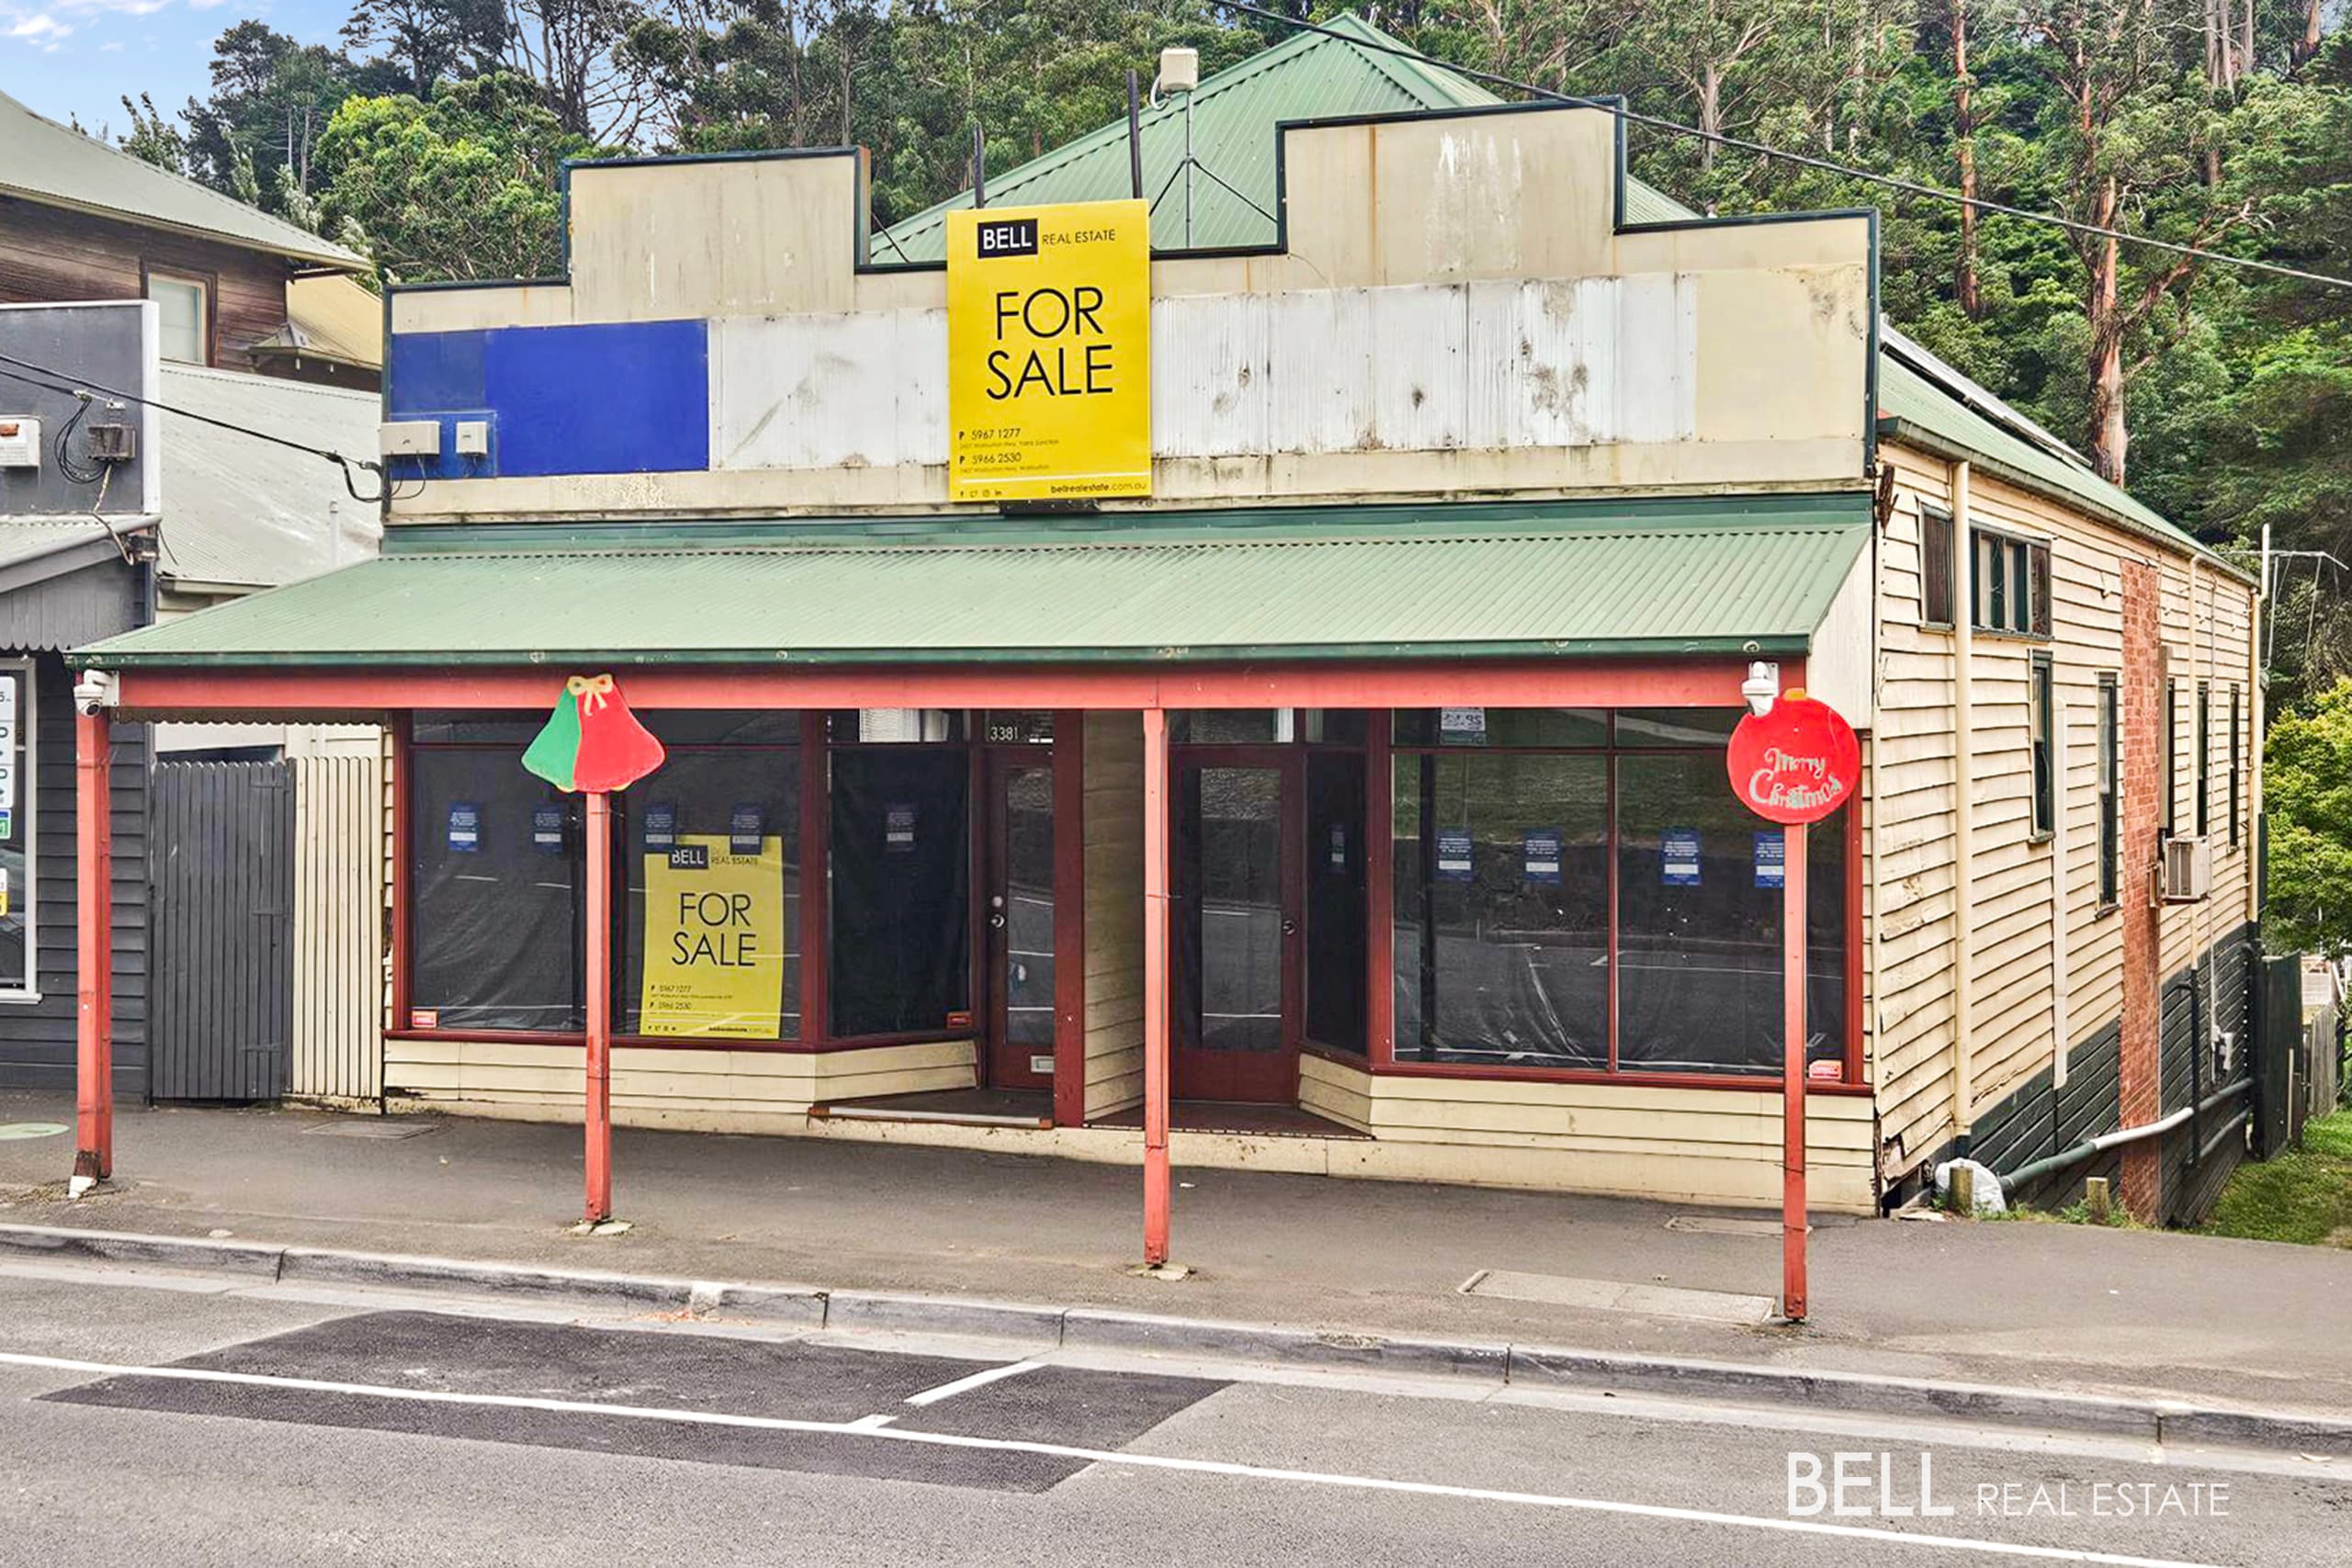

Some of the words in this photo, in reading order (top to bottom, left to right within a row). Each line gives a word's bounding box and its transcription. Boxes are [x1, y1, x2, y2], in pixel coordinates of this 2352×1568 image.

[983, 226, 1032, 250] BELL
[1042, 232, 1071, 245] REAL
[1075, 229, 1115, 243] ESTATE
[996, 287, 1103, 340] FOR
[986, 344, 1114, 400] SALE
[959, 431, 965, 440] P
[971, 429, 994, 441] 5967
[998, 428, 1021, 438] 1277
[959, 455, 965, 465] P
[972, 454, 996, 464] 5966
[997, 452, 1022, 463] 2530
[1050, 483, 1148, 493] bellrealestate.com.au
[990, 726, 1018, 741] 3381
[1764, 748, 1826, 779] Merry
[1749, 769, 1843, 809] Christmas
[672, 849, 705, 865] BELL
[680, 892, 752, 927] FOR
[672, 931, 756, 967] SALE
